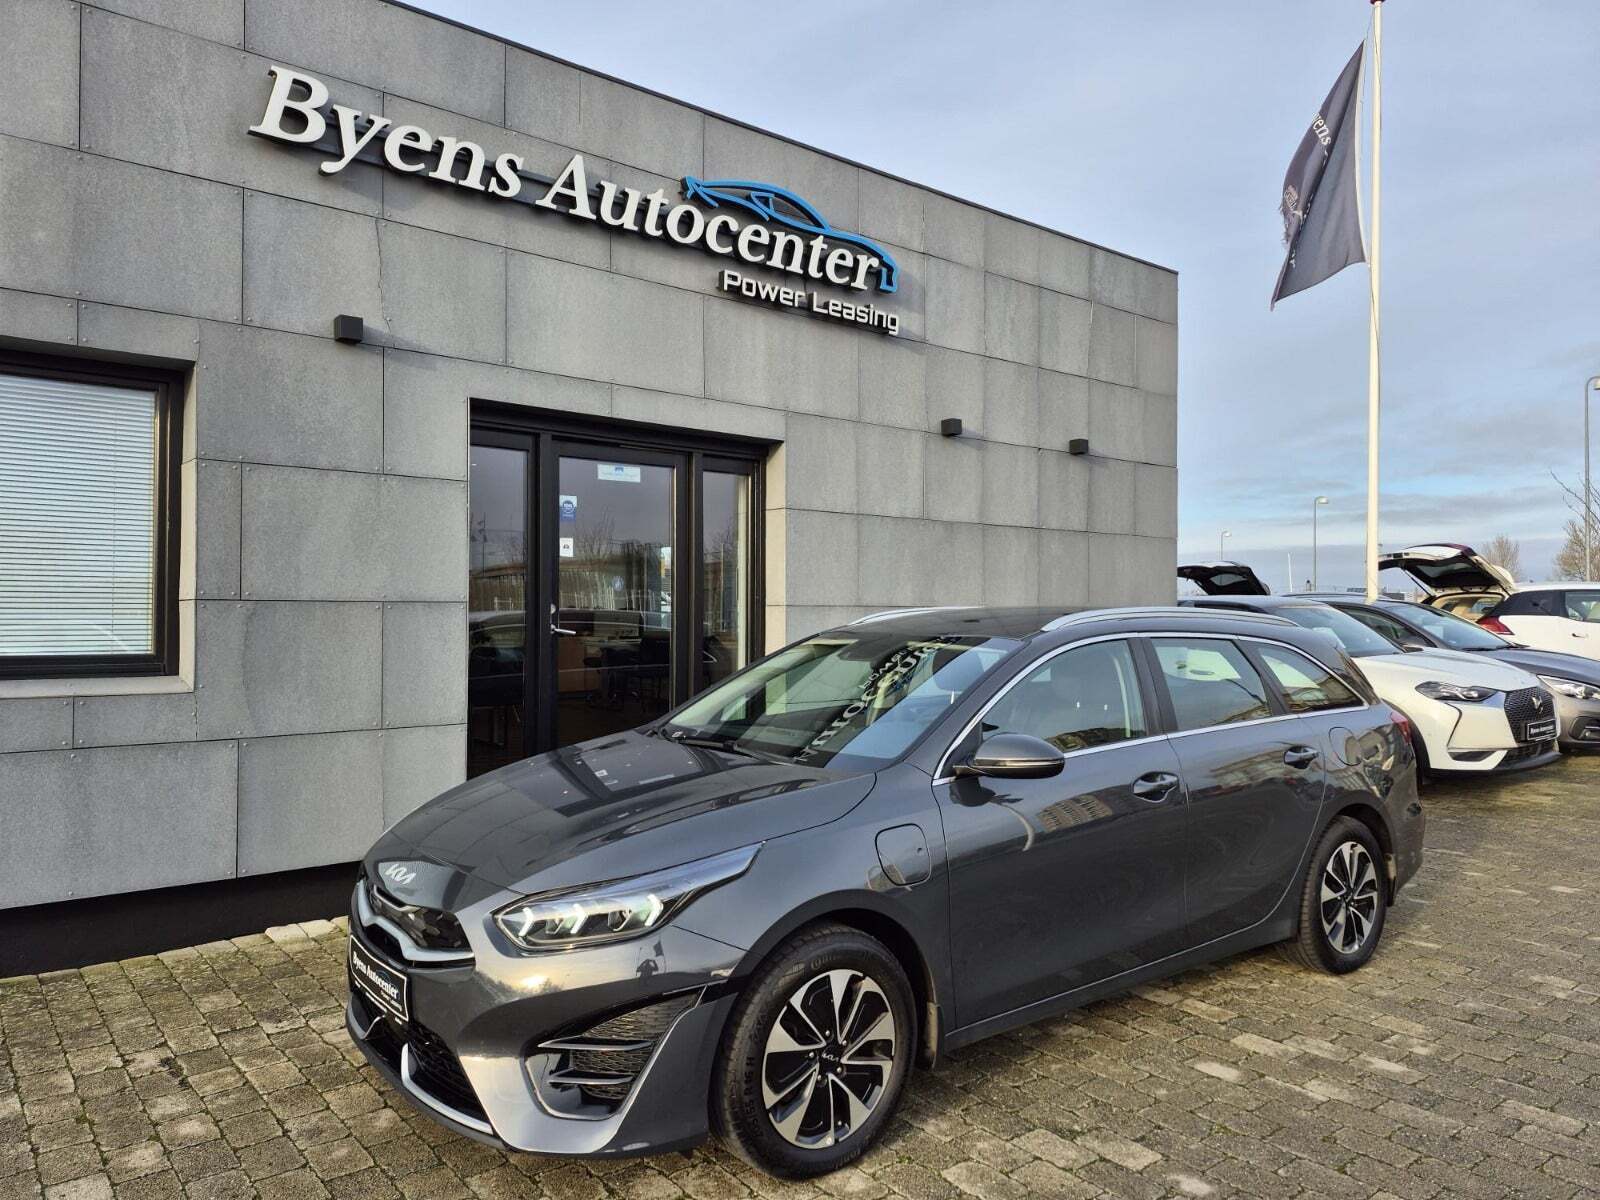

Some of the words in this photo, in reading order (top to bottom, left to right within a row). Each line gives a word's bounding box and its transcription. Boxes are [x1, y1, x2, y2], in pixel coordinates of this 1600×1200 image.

[248, 65, 524, 198] Byens
[535, 154, 879, 291] Autocenter
[722, 268, 806, 308] Power
[811, 291, 900, 336] Leasing
